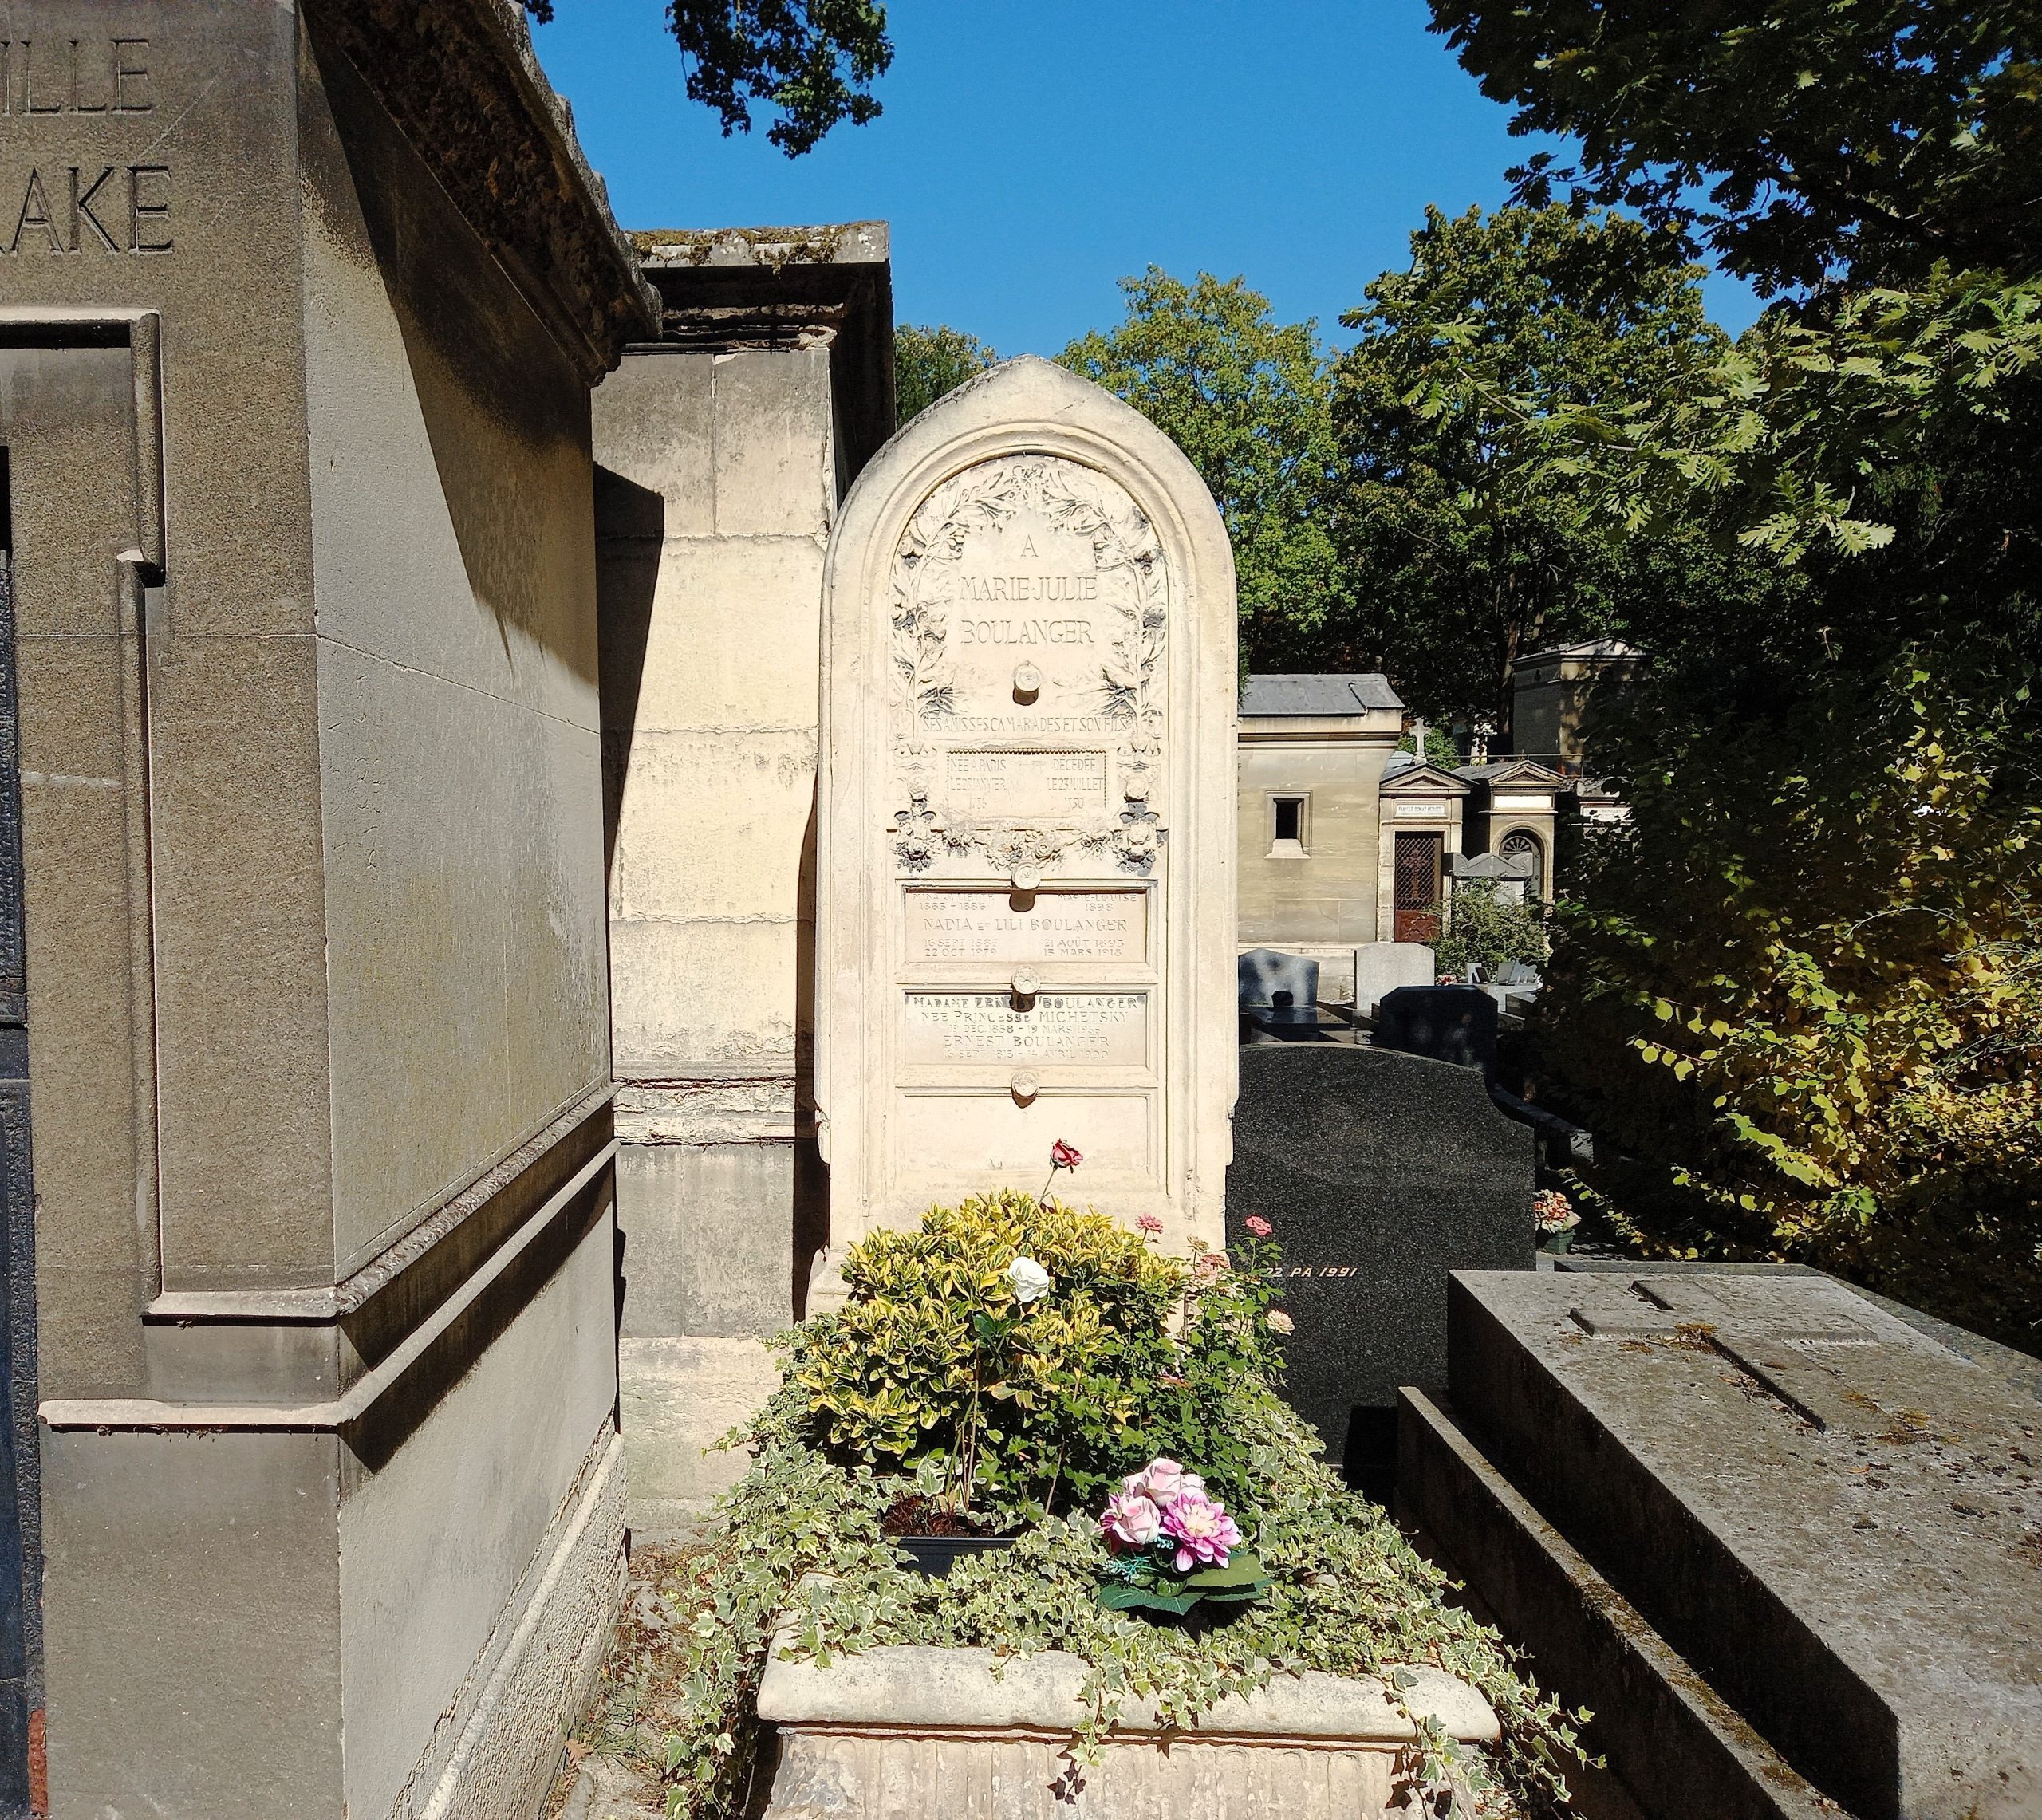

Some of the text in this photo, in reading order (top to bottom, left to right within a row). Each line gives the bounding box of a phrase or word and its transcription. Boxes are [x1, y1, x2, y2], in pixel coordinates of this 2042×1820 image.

[0, 166, 173, 255] AKE
[960, 620, 1095, 644] BOULANGER
[991, 717, 1061, 732] CAMARADES
[1063, 717, 1078, 732] ET
[1079, 717, 1101, 732] SON
[924, 918, 973, 931] NADIA
[995, 919, 1023, 931] LILI
[1030, 919, 1128, 932] BOULANGER
[925, 948, 938, 957] 22
[942, 948, 966, 957] OCT
[1060, 948, 1092, 957] MARS
[913, 997, 968, 1009] MADAME
[1043, 997, 1137, 1009] BOULANGER
[954, 1010, 1031, 1022] PRINCESSE
[1039, 1011, 1128, 1023] MICHETSKY
[1043, 1024, 1072, 1034] MARS
[944, 1035, 1110, 1047] ERNEST BOULANGER
[1289, 1267, 1313, 1277] PA
[1319, 1267, 1358, 1277] 1991
